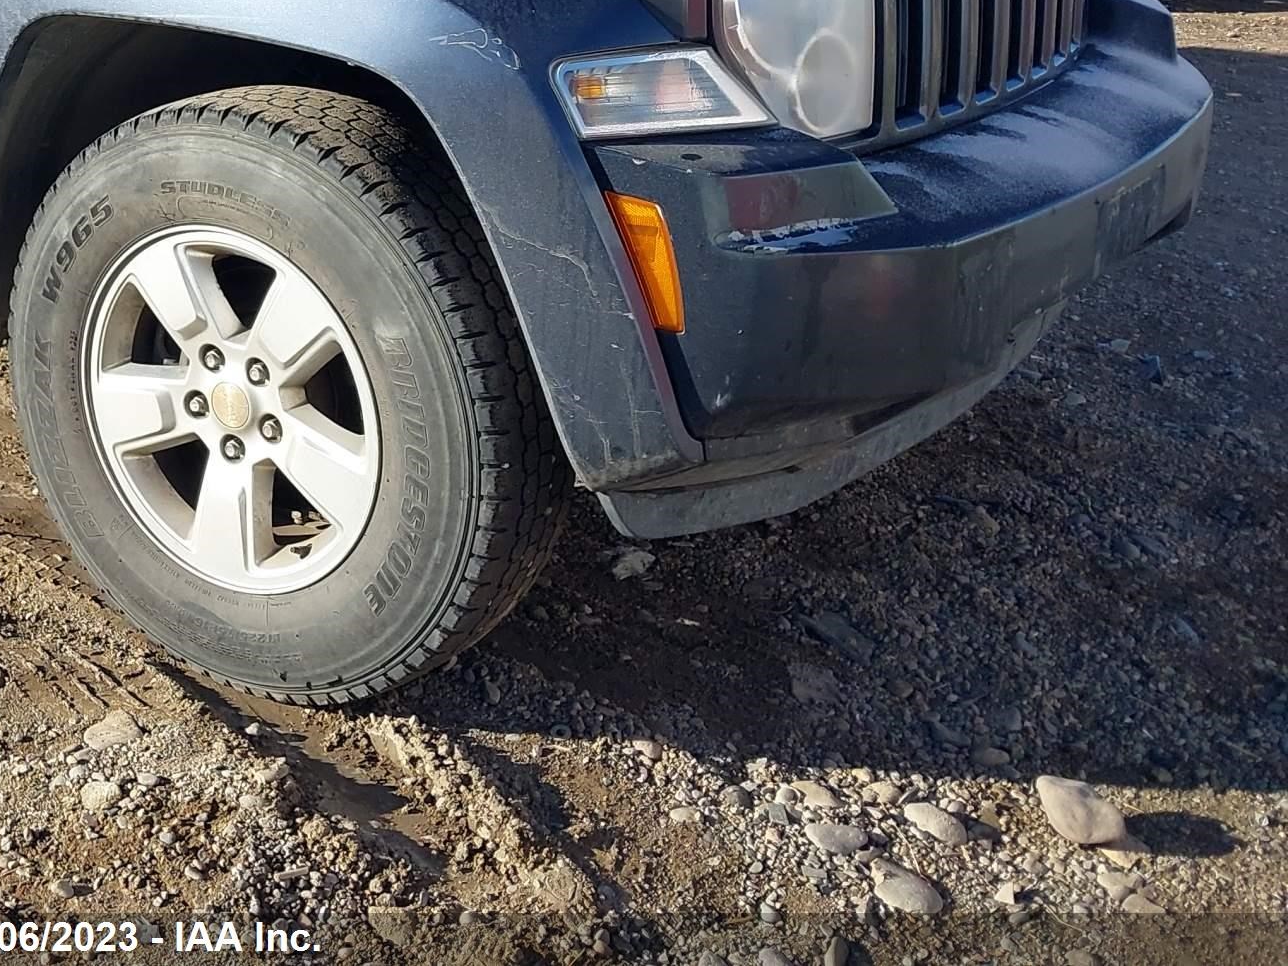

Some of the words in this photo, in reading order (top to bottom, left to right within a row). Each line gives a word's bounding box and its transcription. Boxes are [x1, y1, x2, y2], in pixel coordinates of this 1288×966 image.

[41, 194, 113, 303] W965
[160, 180, 291, 229] STUDLESS
[33, 329, 106, 538] BLIZZAK
[364, 336, 431, 618] BRIDGESTONE
